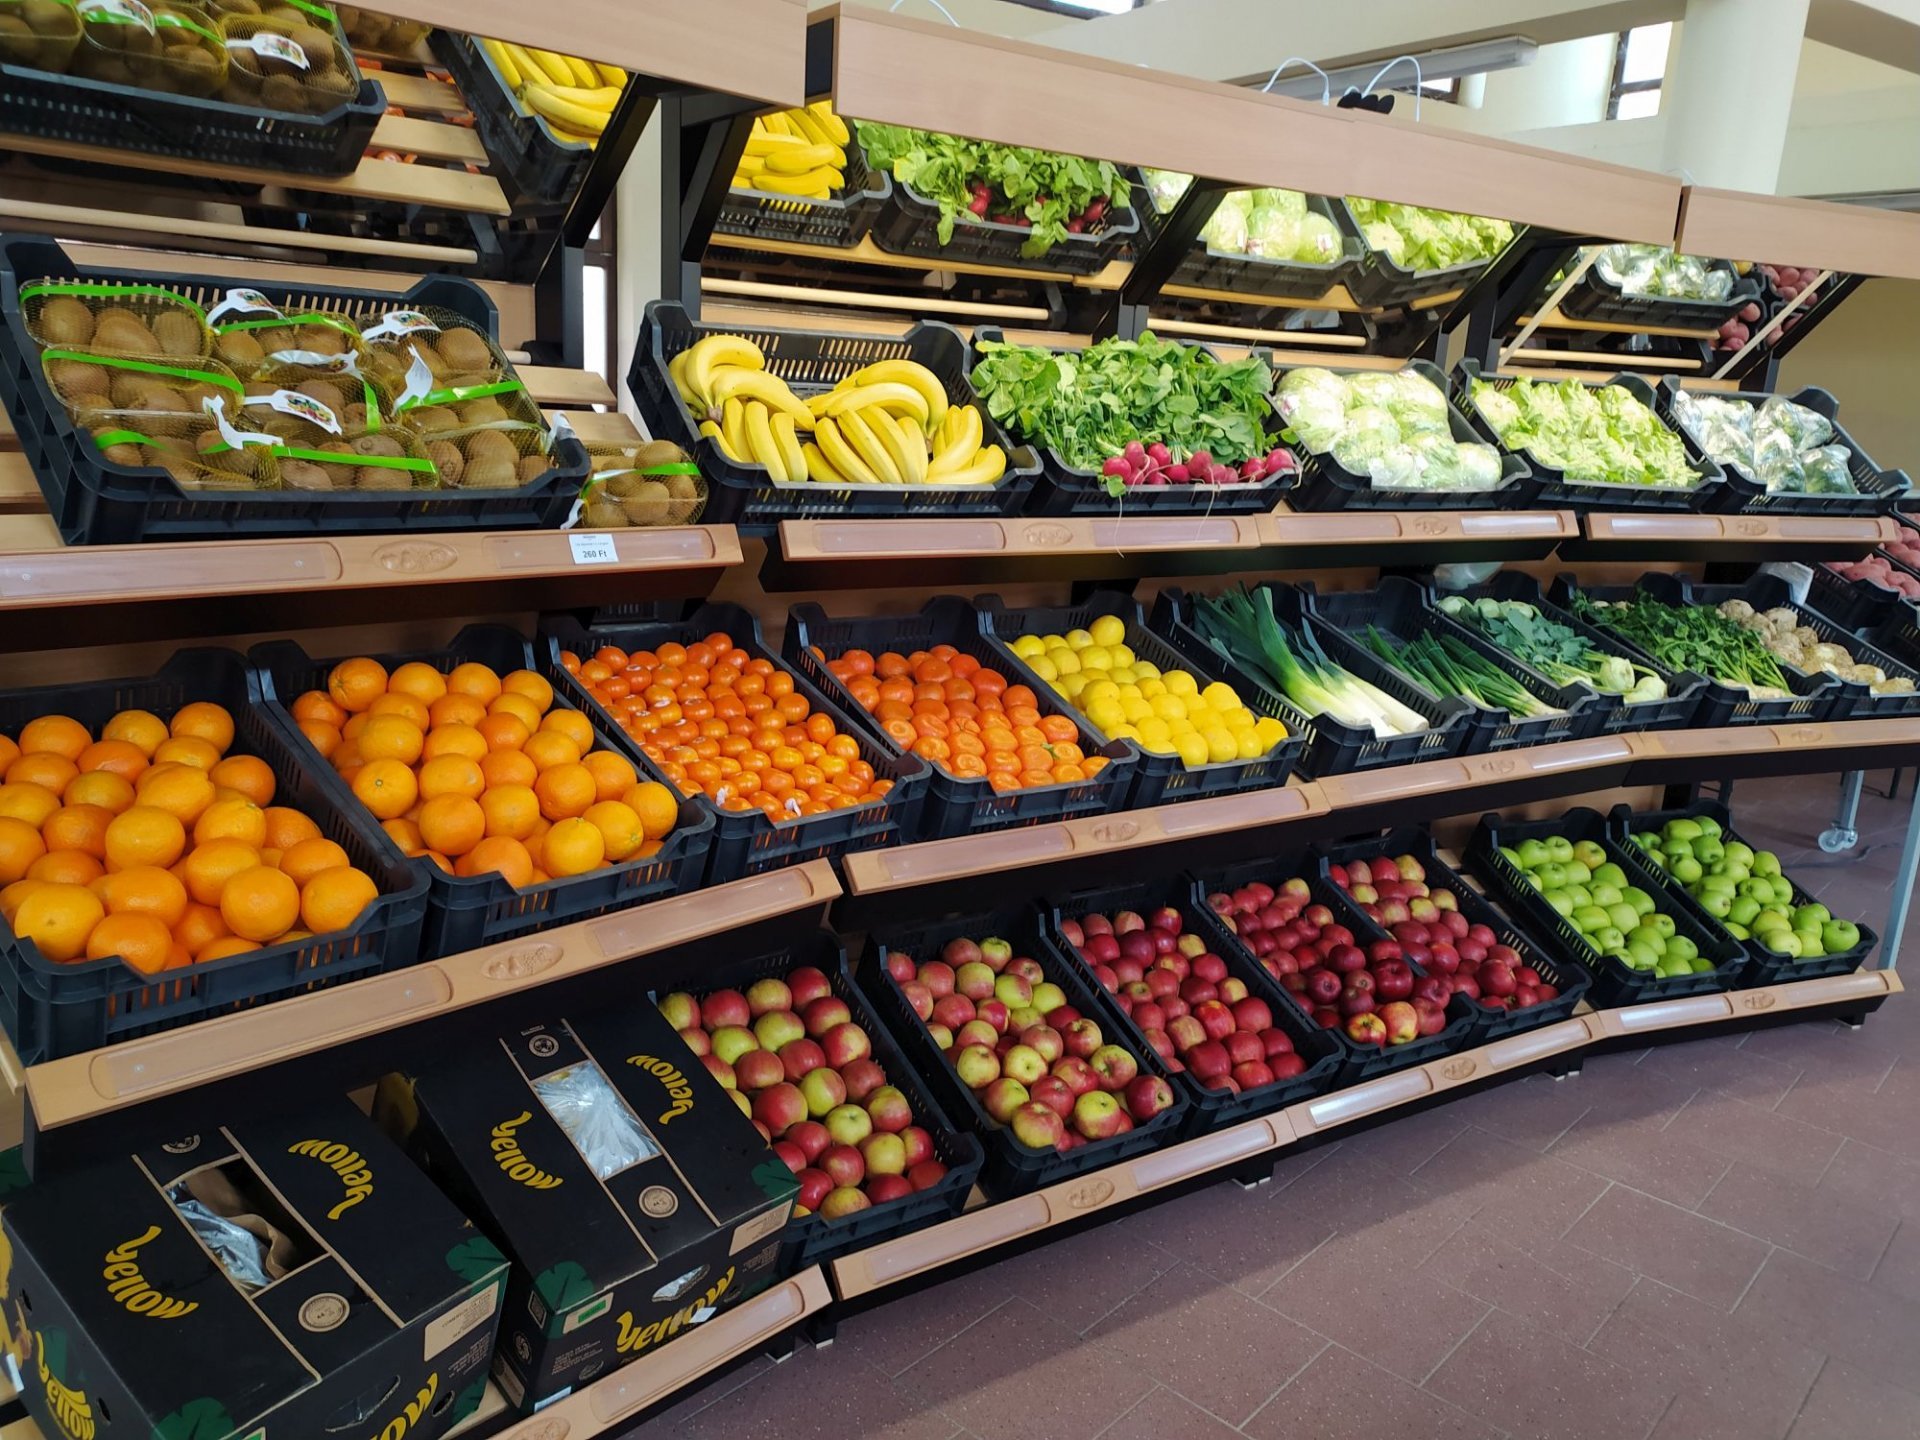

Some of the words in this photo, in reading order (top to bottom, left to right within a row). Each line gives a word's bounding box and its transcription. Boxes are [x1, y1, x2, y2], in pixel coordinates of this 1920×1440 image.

[582, 550, 597, 559] 260
[598, 549, 607, 558] Ft
[625, 1054, 694, 1125] yellow
[287, 1139, 374, 1220] yellow
[490, 1110, 564, 1189] yellow
[103, 1225, 199, 1319] yellow
